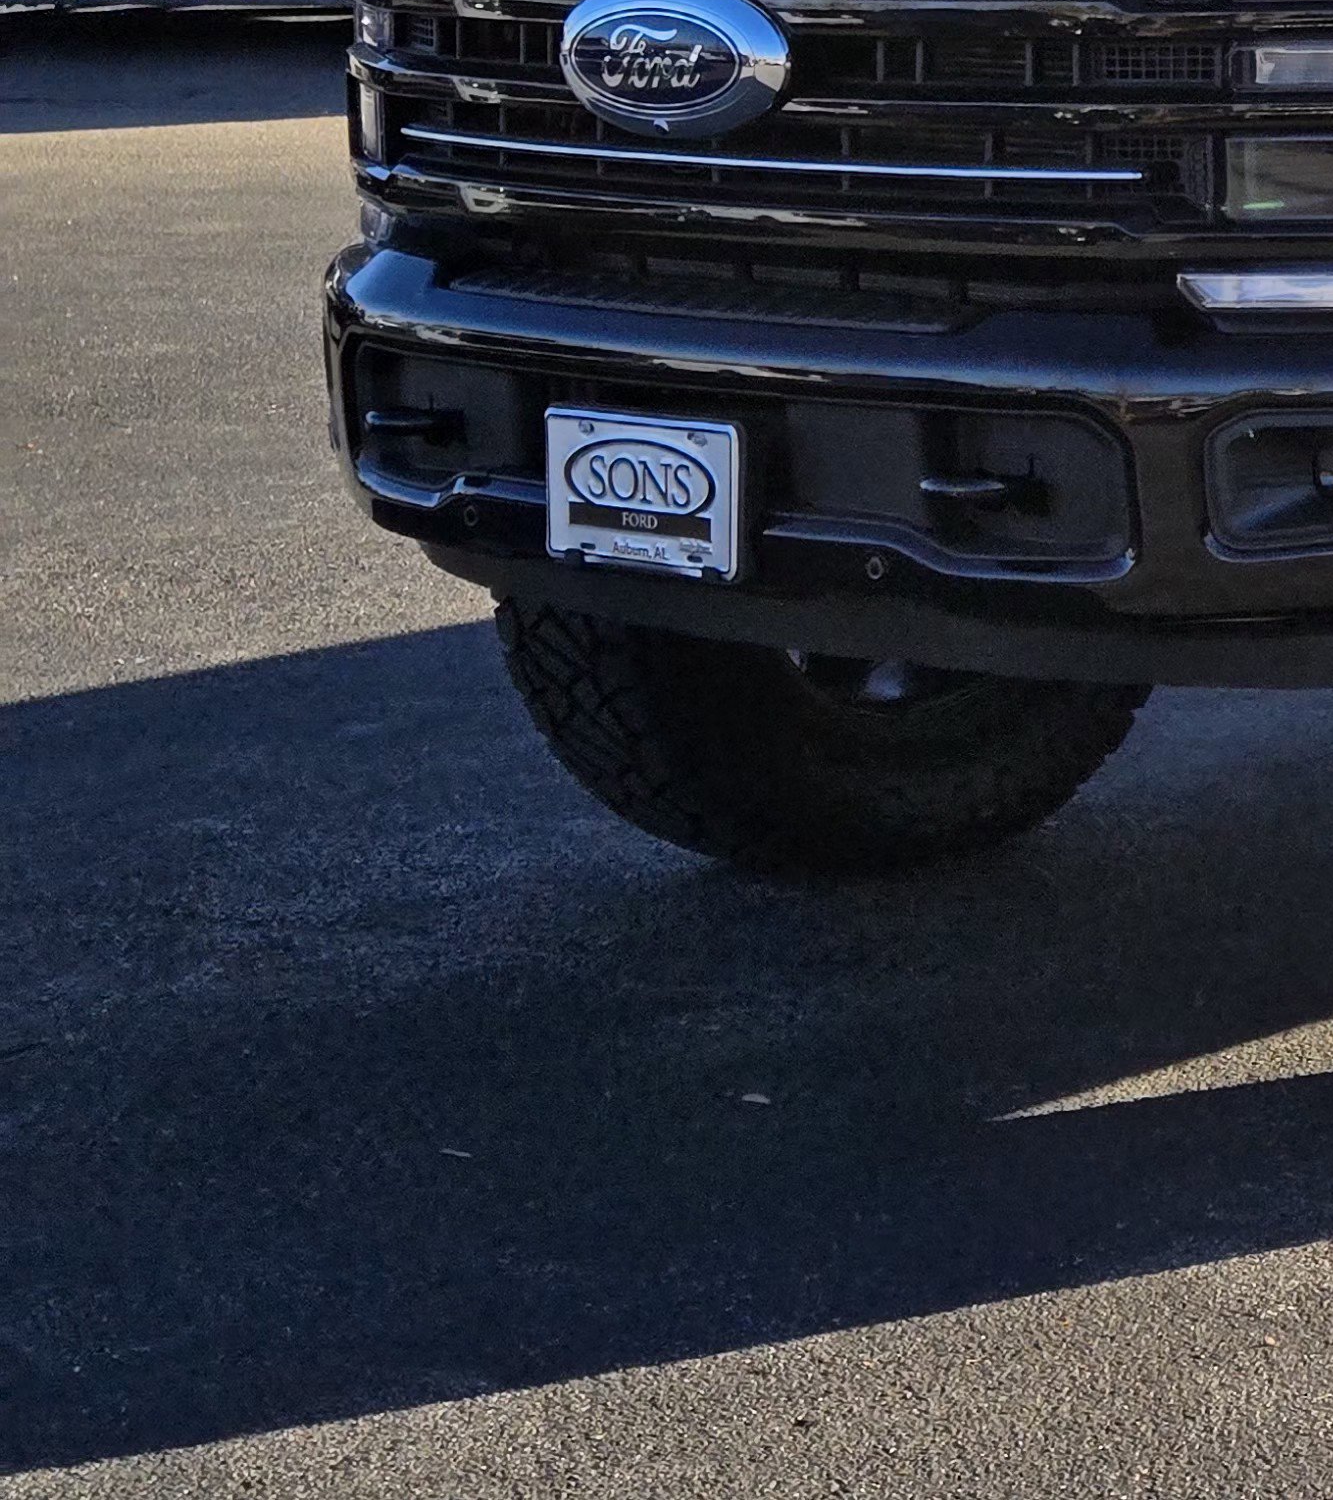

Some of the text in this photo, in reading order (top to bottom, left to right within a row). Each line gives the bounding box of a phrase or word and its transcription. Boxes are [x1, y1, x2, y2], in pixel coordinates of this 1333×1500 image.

[600, 23, 703, 89] Ford
[588, 454, 692, 508] SONS
[621, 511, 658, 530] FORD
[613, 541, 652, 559] Auburn,
[654, 546, 670, 561] AL
